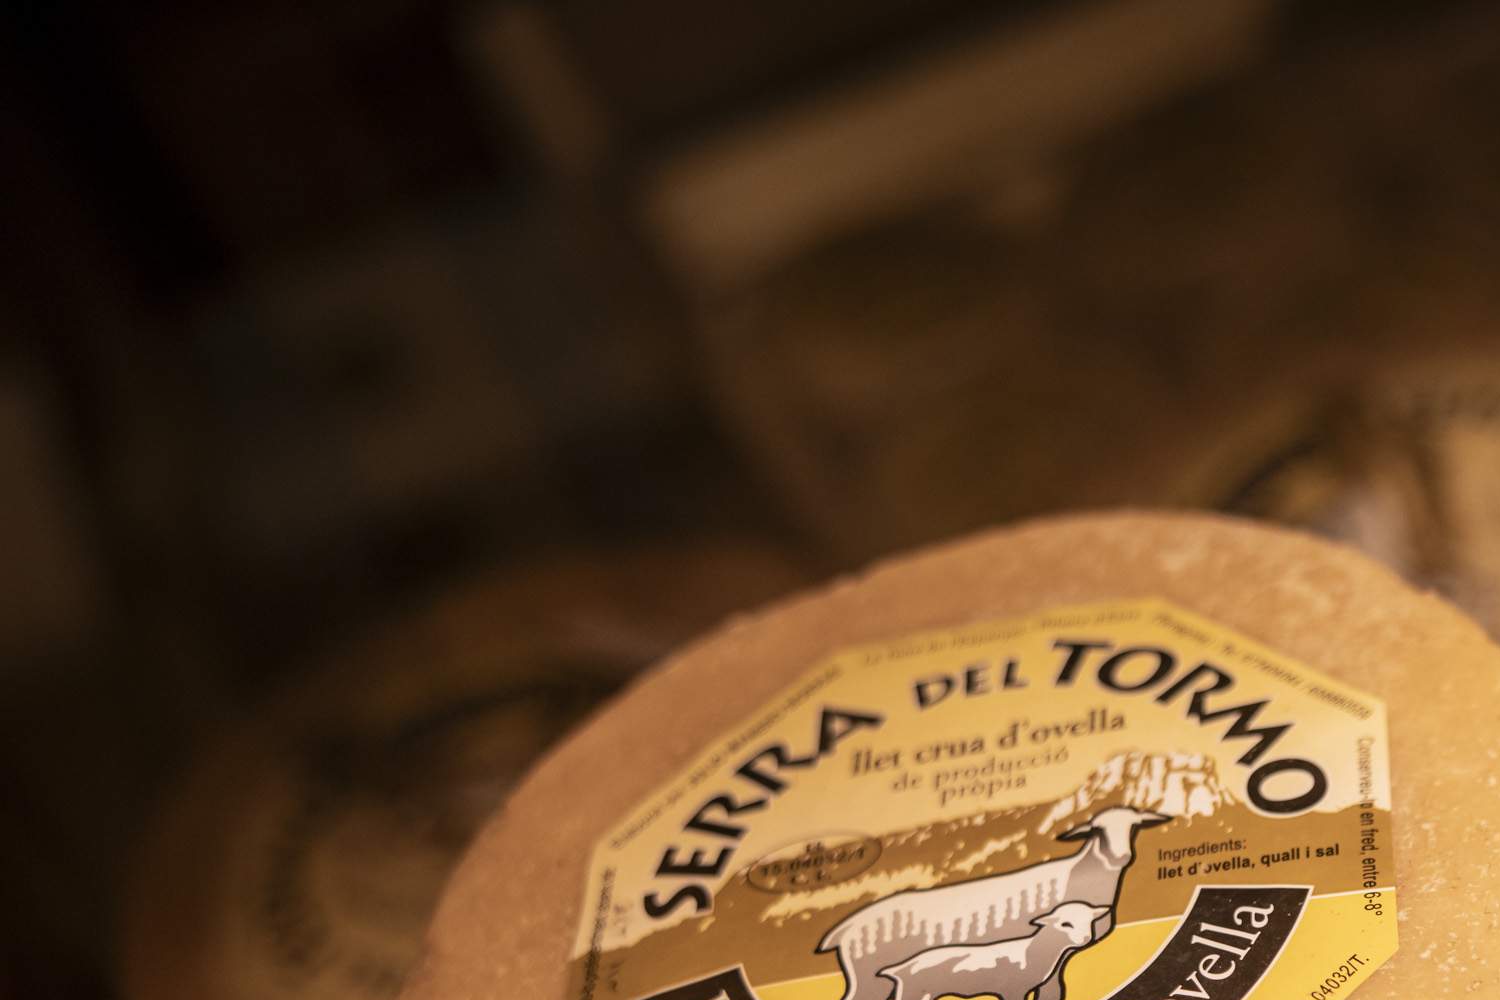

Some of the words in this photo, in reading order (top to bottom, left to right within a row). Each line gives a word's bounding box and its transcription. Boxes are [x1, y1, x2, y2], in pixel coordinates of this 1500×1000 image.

[851, 749, 900, 777] llet
[914, 737, 985, 764] crua
[998, 707, 1125, 749] d'ovella
[643, 706, 886, 919] SERRA
[913, 659, 1029, 710] DEL
[1052, 640, 1327, 814] TORMO
[892, 772, 923, 792] de
[934, 746, 1070, 790] producció
[940, 775, 1027, 808] pròpia
[1360, 812, 1374, 826] en
[1158, 839, 1247, 862] Ingredients:
[1360, 828, 1379, 855] fred,
[1157, 866, 1183, 880] llet
[1260, 848, 1300, 867] quall
[1315, 843, 1340, 858] sal
[1362, 857, 1380, 888] entre
